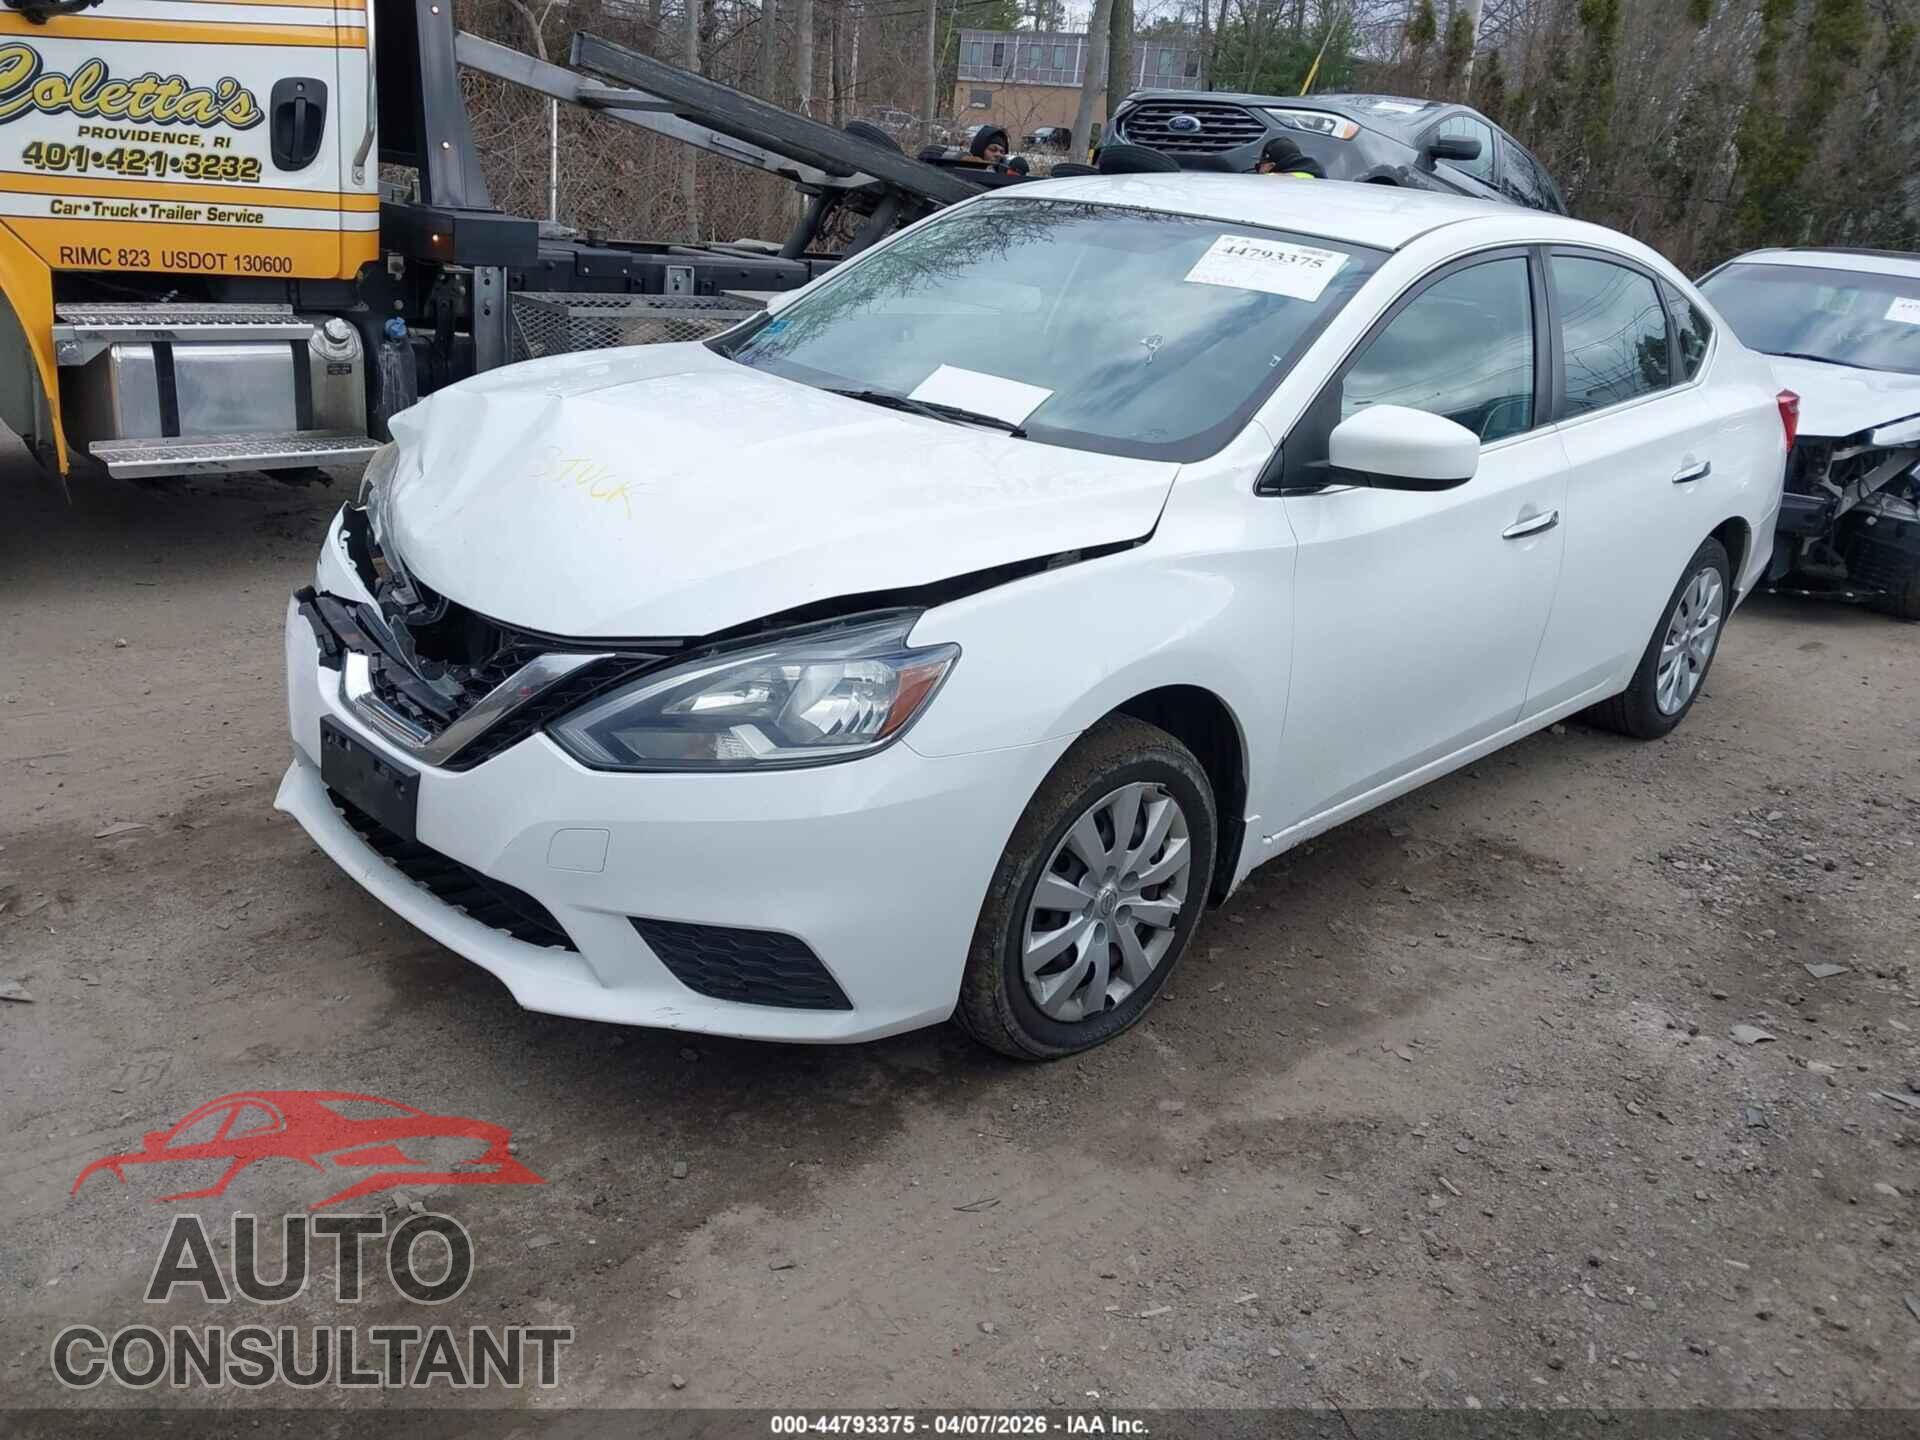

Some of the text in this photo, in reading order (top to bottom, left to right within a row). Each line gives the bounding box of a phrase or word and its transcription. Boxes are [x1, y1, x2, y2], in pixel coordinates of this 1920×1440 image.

[0, 42, 265, 129] Coletta's
[78, 125, 231, 149] PROVIDENCE, RI
[207, 207, 264, 224] Service
[60, 246, 292, 273] RIMC 823 USDOT 130600
[1222, 245, 1327, 269] 44793375
